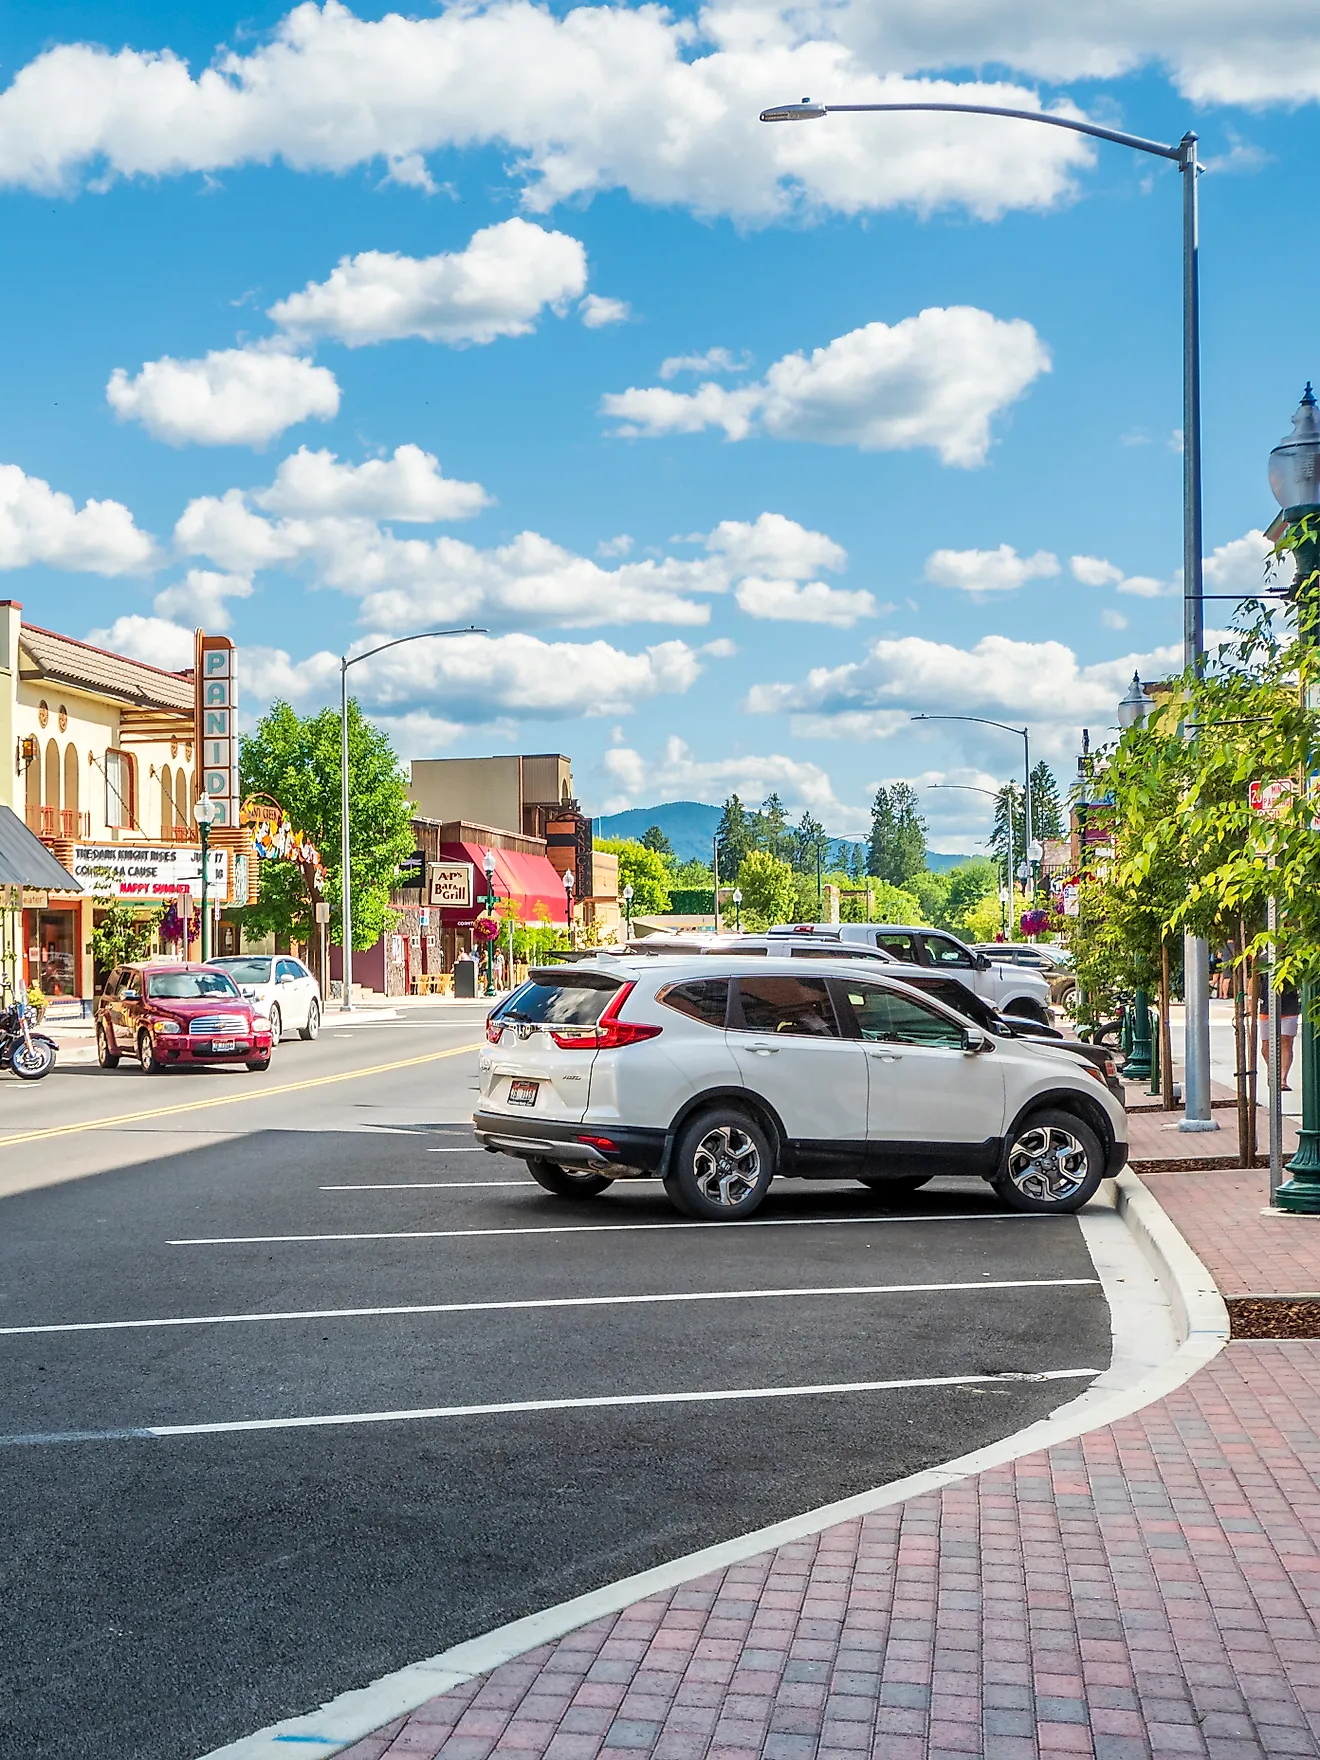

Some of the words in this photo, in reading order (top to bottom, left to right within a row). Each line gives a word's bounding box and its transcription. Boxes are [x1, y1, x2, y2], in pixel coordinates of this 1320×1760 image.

[207, 653, 226, 824] PANIDA
[577, 821, 586, 854] SAND
[75, 848, 92, 860] THE
[92, 848, 116, 861] DARK
[118, 849, 148, 862] KNIGHT
[150, 850, 177, 863] RISES
[214, 853, 223, 864] 17
[128, 867, 158, 878] CAUSE
[577, 856, 586, 896] CREEK
[120, 882, 150, 895] HAPPY
[152, 884, 191, 895] SUMMER
[434, 883, 453, 895] Bar
[442, 886, 466, 900] Grill
